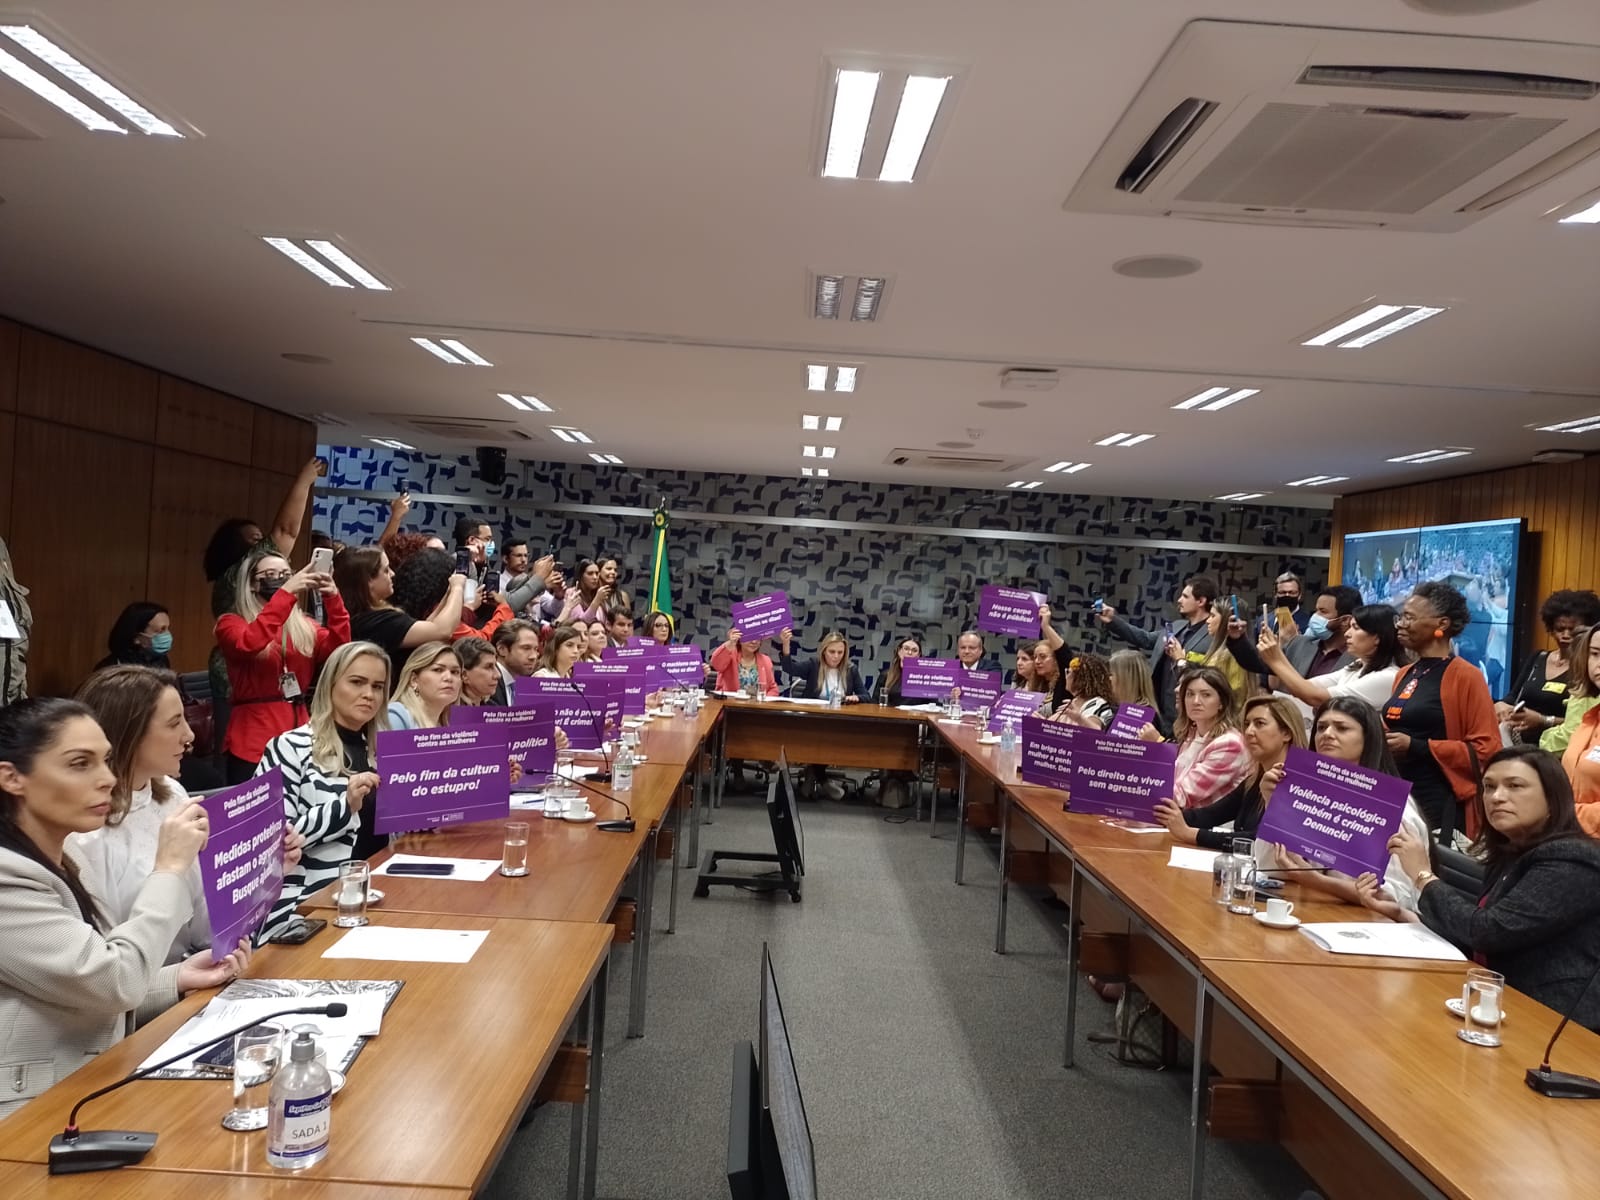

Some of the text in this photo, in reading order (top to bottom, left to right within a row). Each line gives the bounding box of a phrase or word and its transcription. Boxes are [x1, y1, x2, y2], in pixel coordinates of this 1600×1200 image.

[559, 708, 573, 717] não
[512, 738, 548, 750] política
[1040, 744, 1057, 754] briga
[1120, 748, 1144, 756] mulheres
[1123, 743, 1146, 751] violência
[1028, 750, 1049, 760] mulher
[1034, 760, 1057, 770] mulher.
[1316, 760, 1330, 770] Pelo
[1330, 764, 1340, 772] fim
[1350, 771, 1378, 786] violência
[389, 765, 500, 784] Pelo fim da cultura
[1078, 766, 1166, 787] Pelo direito de viver
[1317, 768, 1336, 778] contra
[1345, 776, 1373, 790] mulheres
[412, 780, 480, 796] do estupro!
[1089, 780, 1151, 796] sem agressão!
[1289, 784, 1387, 827] Violência psicológica
[1292, 799, 1375, 836] também é crime!
[1302, 817, 1352, 842] Denuncie!
[214, 839, 251, 870] Medidas
[217, 860, 251, 890] afastam
[252, 857, 257, 868] o
[232, 876, 259, 904] Busque
[292, 1125, 320, 1139] SADA
